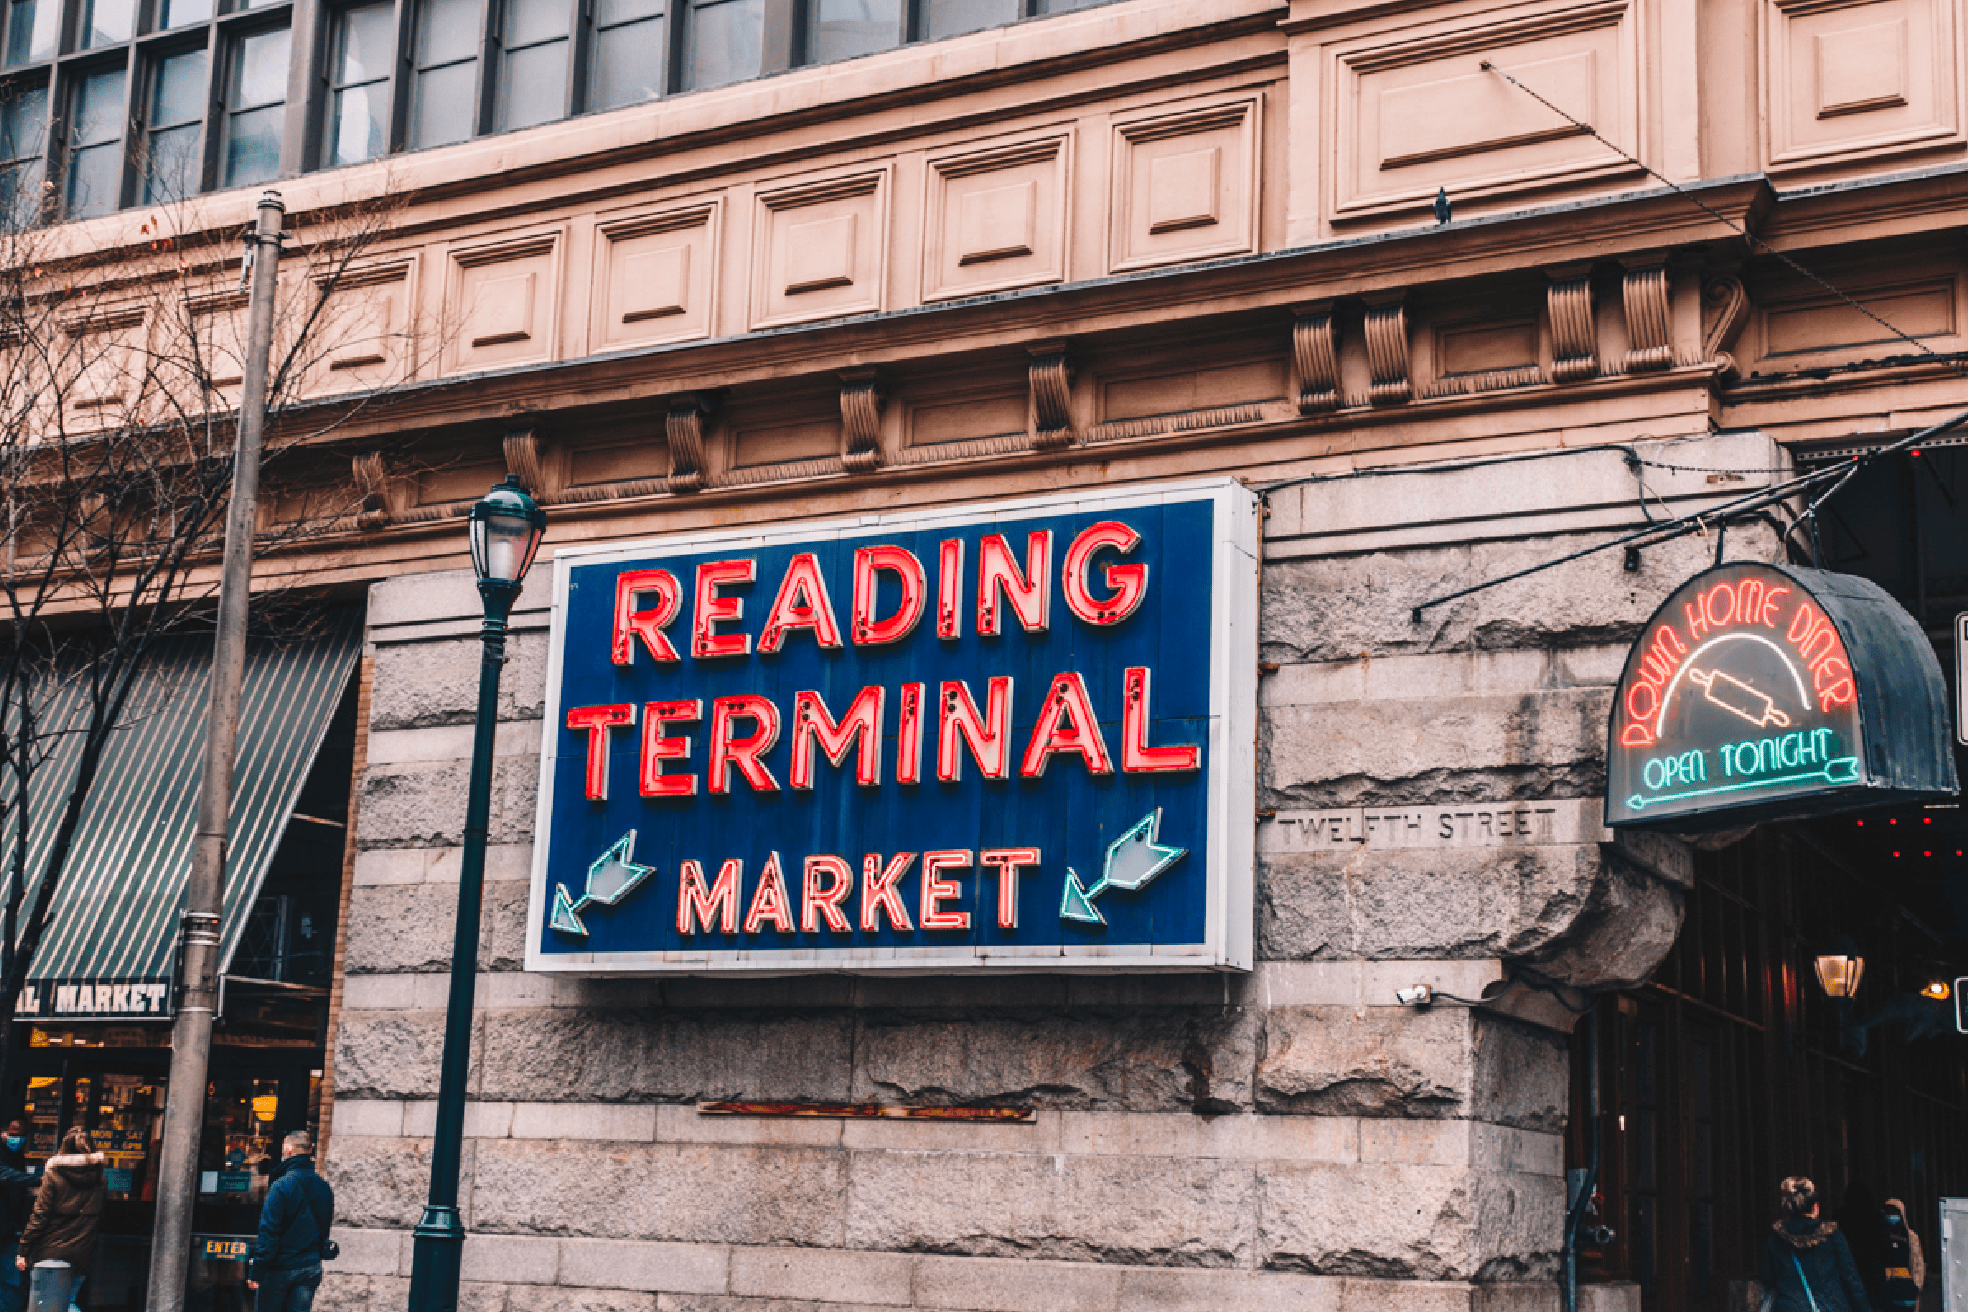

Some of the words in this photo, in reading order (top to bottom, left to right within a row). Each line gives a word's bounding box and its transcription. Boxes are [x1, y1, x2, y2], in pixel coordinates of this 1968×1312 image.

[611, 519, 1149, 667] READING
[1620, 624, 1689, 748] DOWN
[1684, 578, 1791, 641] HOME
[1786, 602, 1855, 714] DINER
[567, 666, 1202, 801] TERMINAL
[1643, 749, 1708, 791] OPEN
[1720, 726, 1834, 778] TONIGHT
[1277, 812, 1422, 845] TWELFTH
[1438, 807, 1556, 839] STREET
[676, 845, 1042, 936] MARKET
[54, 983, 167, 1013] MARKET
[206, 1239, 247, 1254] ENTER
